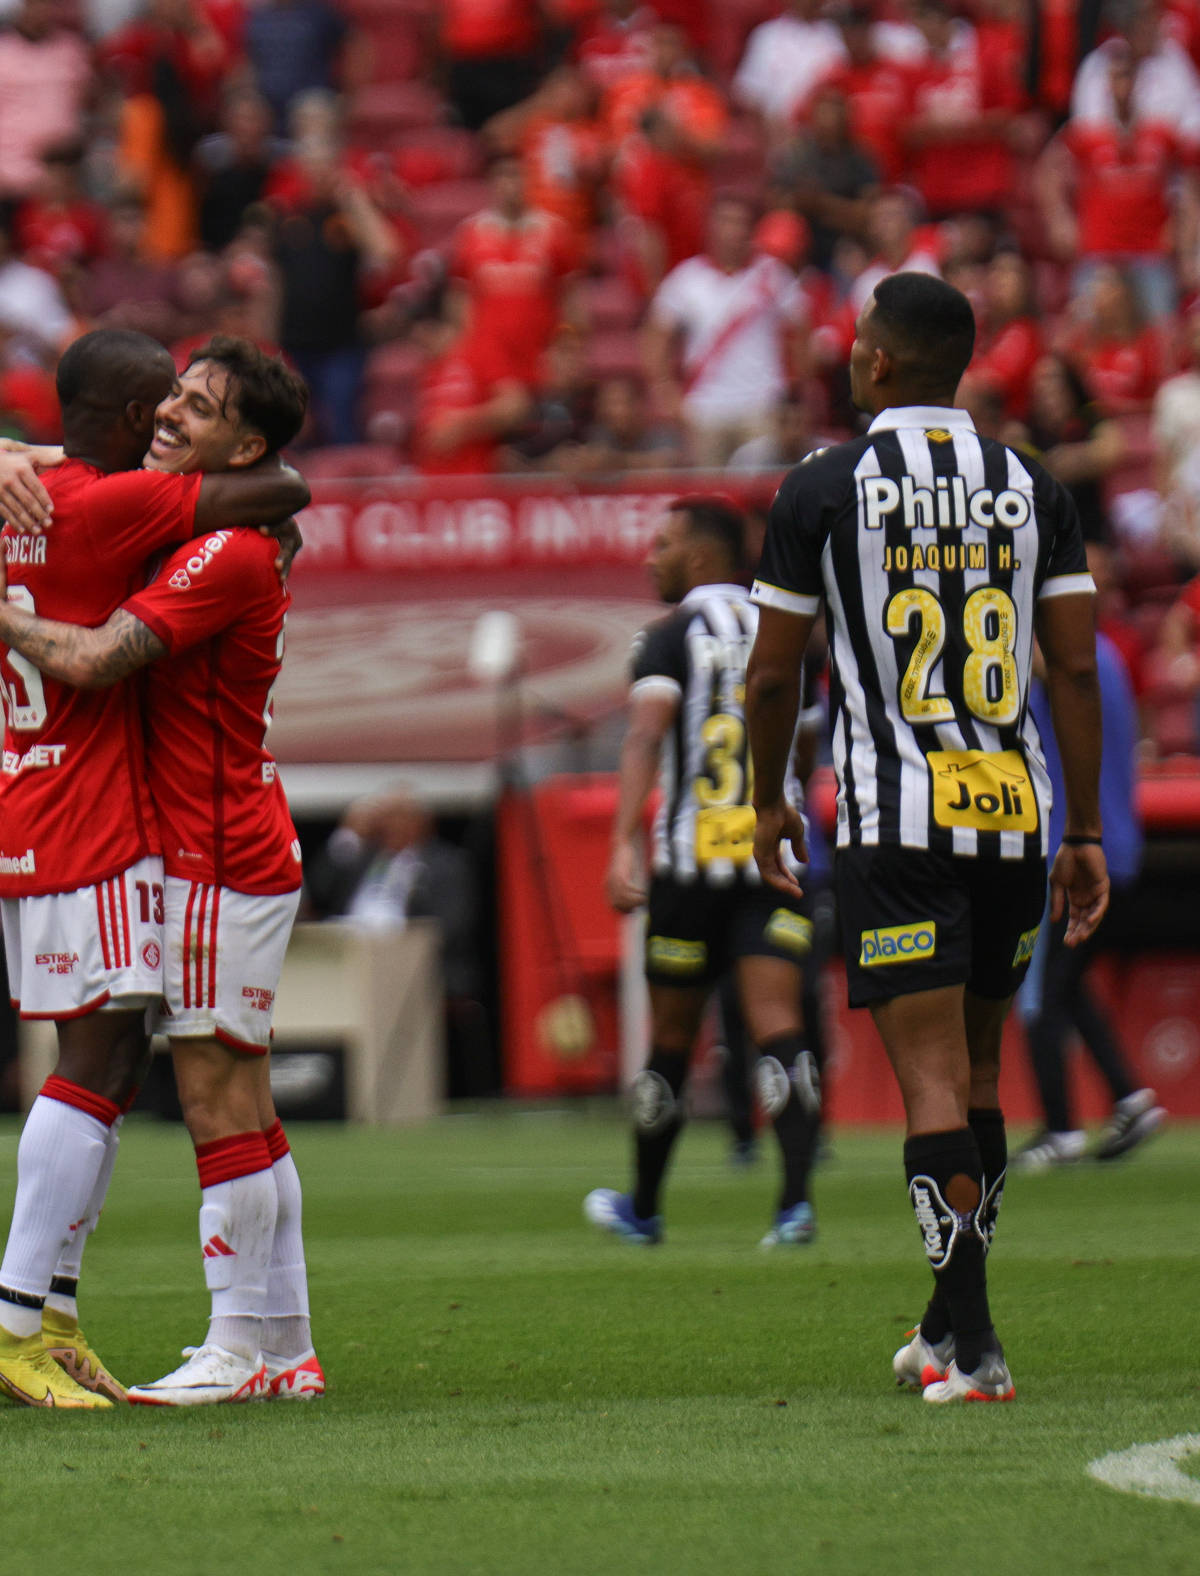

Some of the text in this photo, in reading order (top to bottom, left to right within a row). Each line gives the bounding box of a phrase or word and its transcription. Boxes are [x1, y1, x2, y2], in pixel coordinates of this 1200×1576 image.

[863, 475, 1032, 530] Philco
[884, 543, 1021, 572] JOAQUIM H.
[884, 586, 1020, 725] 28
[947, 781, 1023, 816] Joli
[135, 879, 166, 925] 13
[35, 952, 80, 965] ESTRELA
[862, 929, 934, 964] placo
[56, 964, 75, 974] BET
